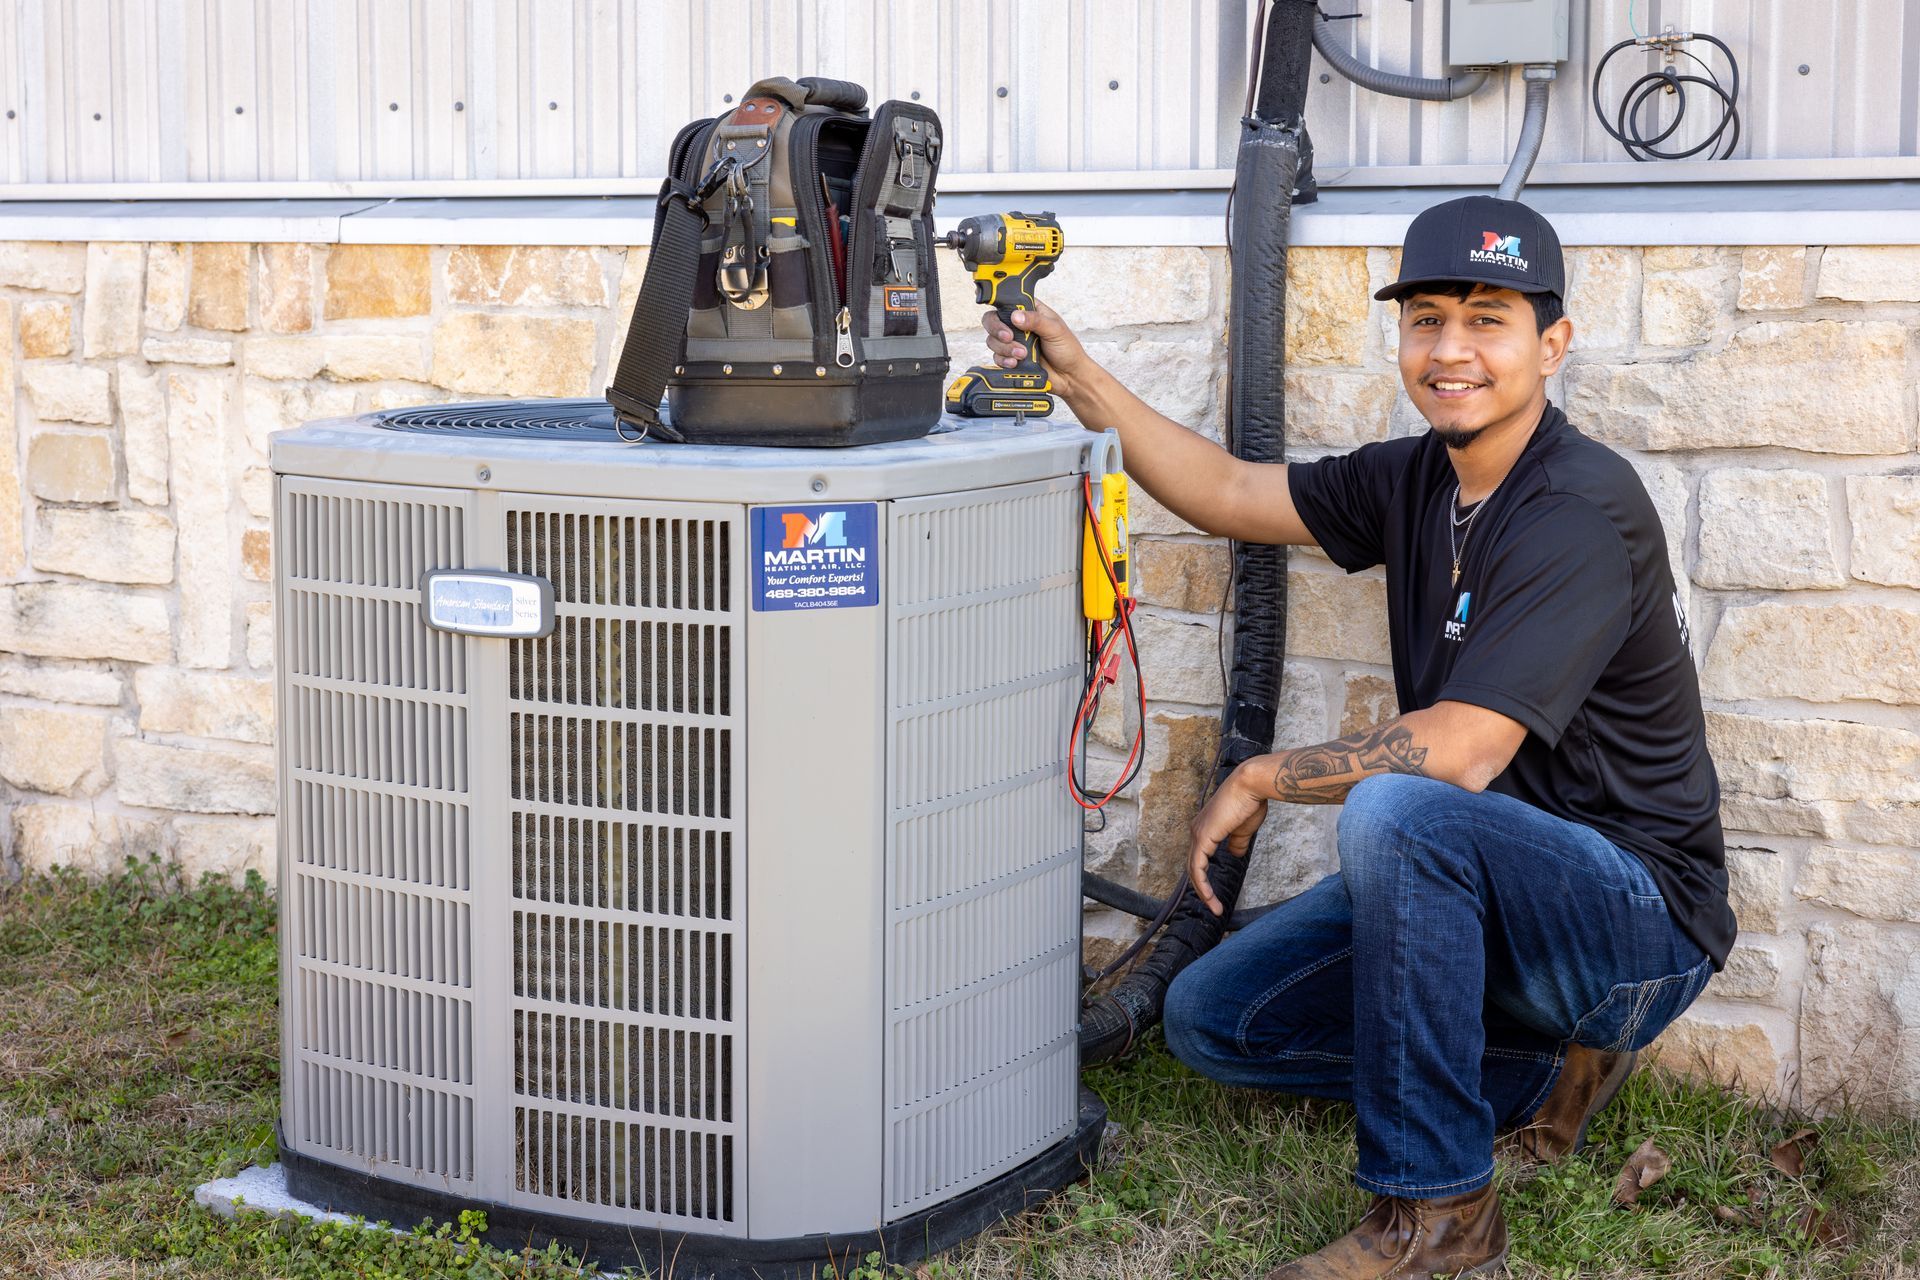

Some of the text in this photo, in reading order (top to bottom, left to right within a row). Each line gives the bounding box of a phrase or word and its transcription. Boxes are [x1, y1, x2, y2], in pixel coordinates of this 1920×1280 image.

[1470, 249, 1529, 270] MARTIN
[764, 547, 866, 566] MARTIN
[767, 572, 864, 586] Your Comfort Experts!
[765, 586, 866, 599] 469-380-9864
